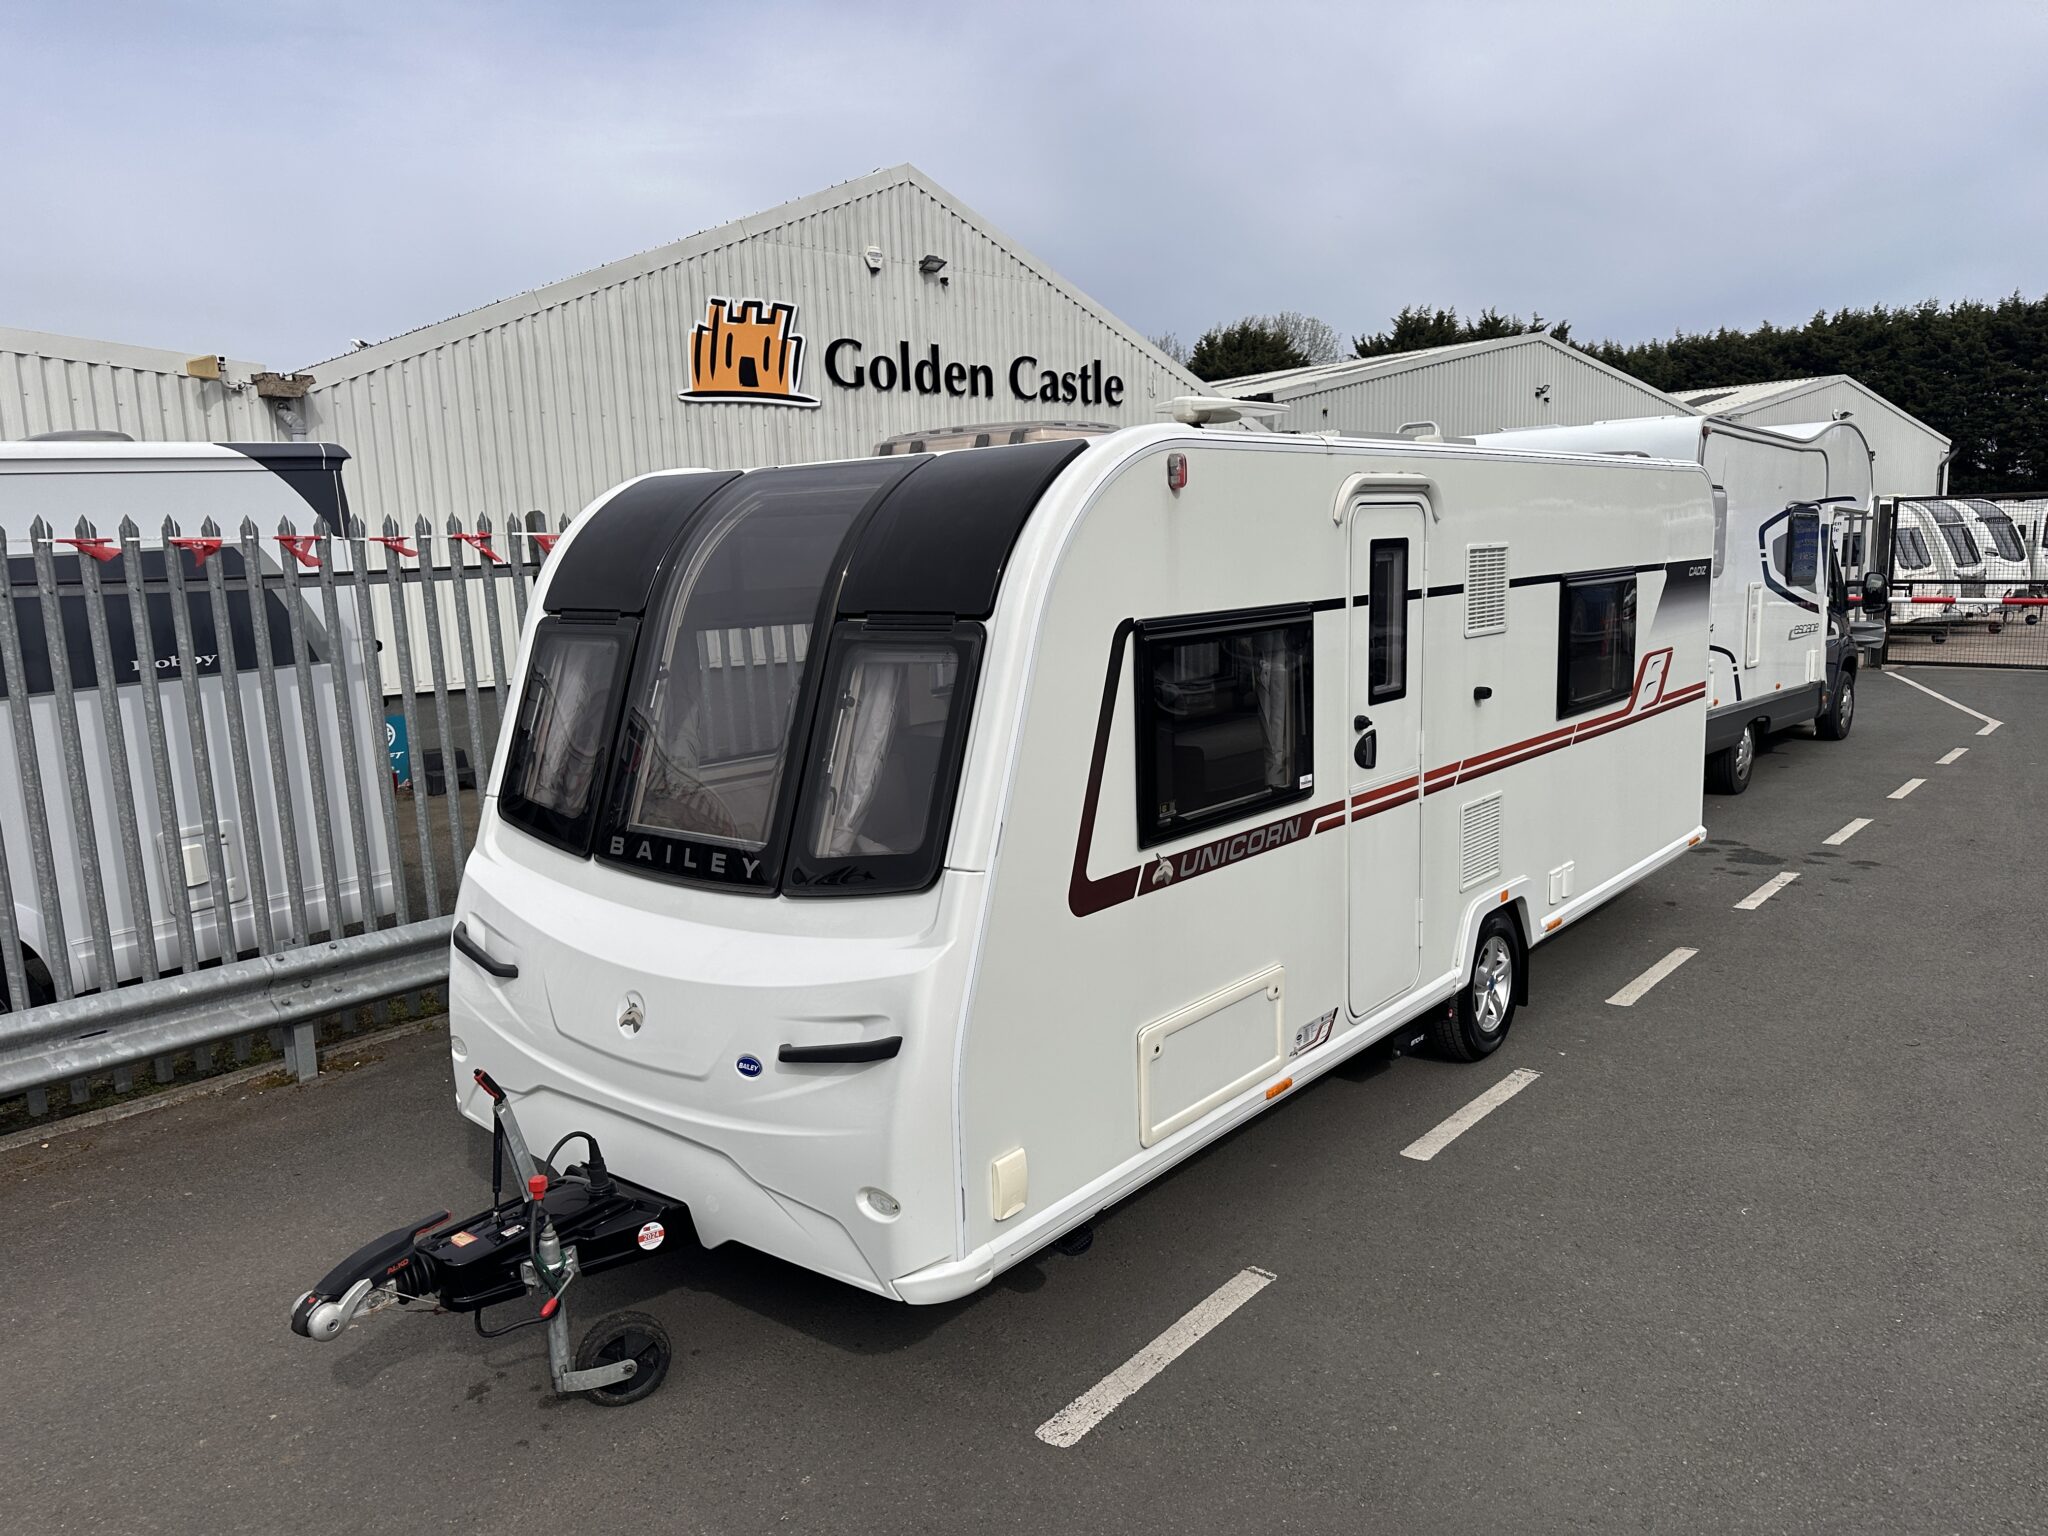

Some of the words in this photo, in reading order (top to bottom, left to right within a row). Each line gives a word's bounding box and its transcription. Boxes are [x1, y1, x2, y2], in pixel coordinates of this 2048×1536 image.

[824, 338, 994, 399] Golden
[1009, 356, 1124, 406] Castle
[1688, 565, 1707, 577] CADIZ
[609, 835, 760, 879] BAILEY
[1179, 816, 1302, 878] UNICORN
[738, 1061, 759, 1072] BAILEY
[643, 1231, 660, 1241] 2024
